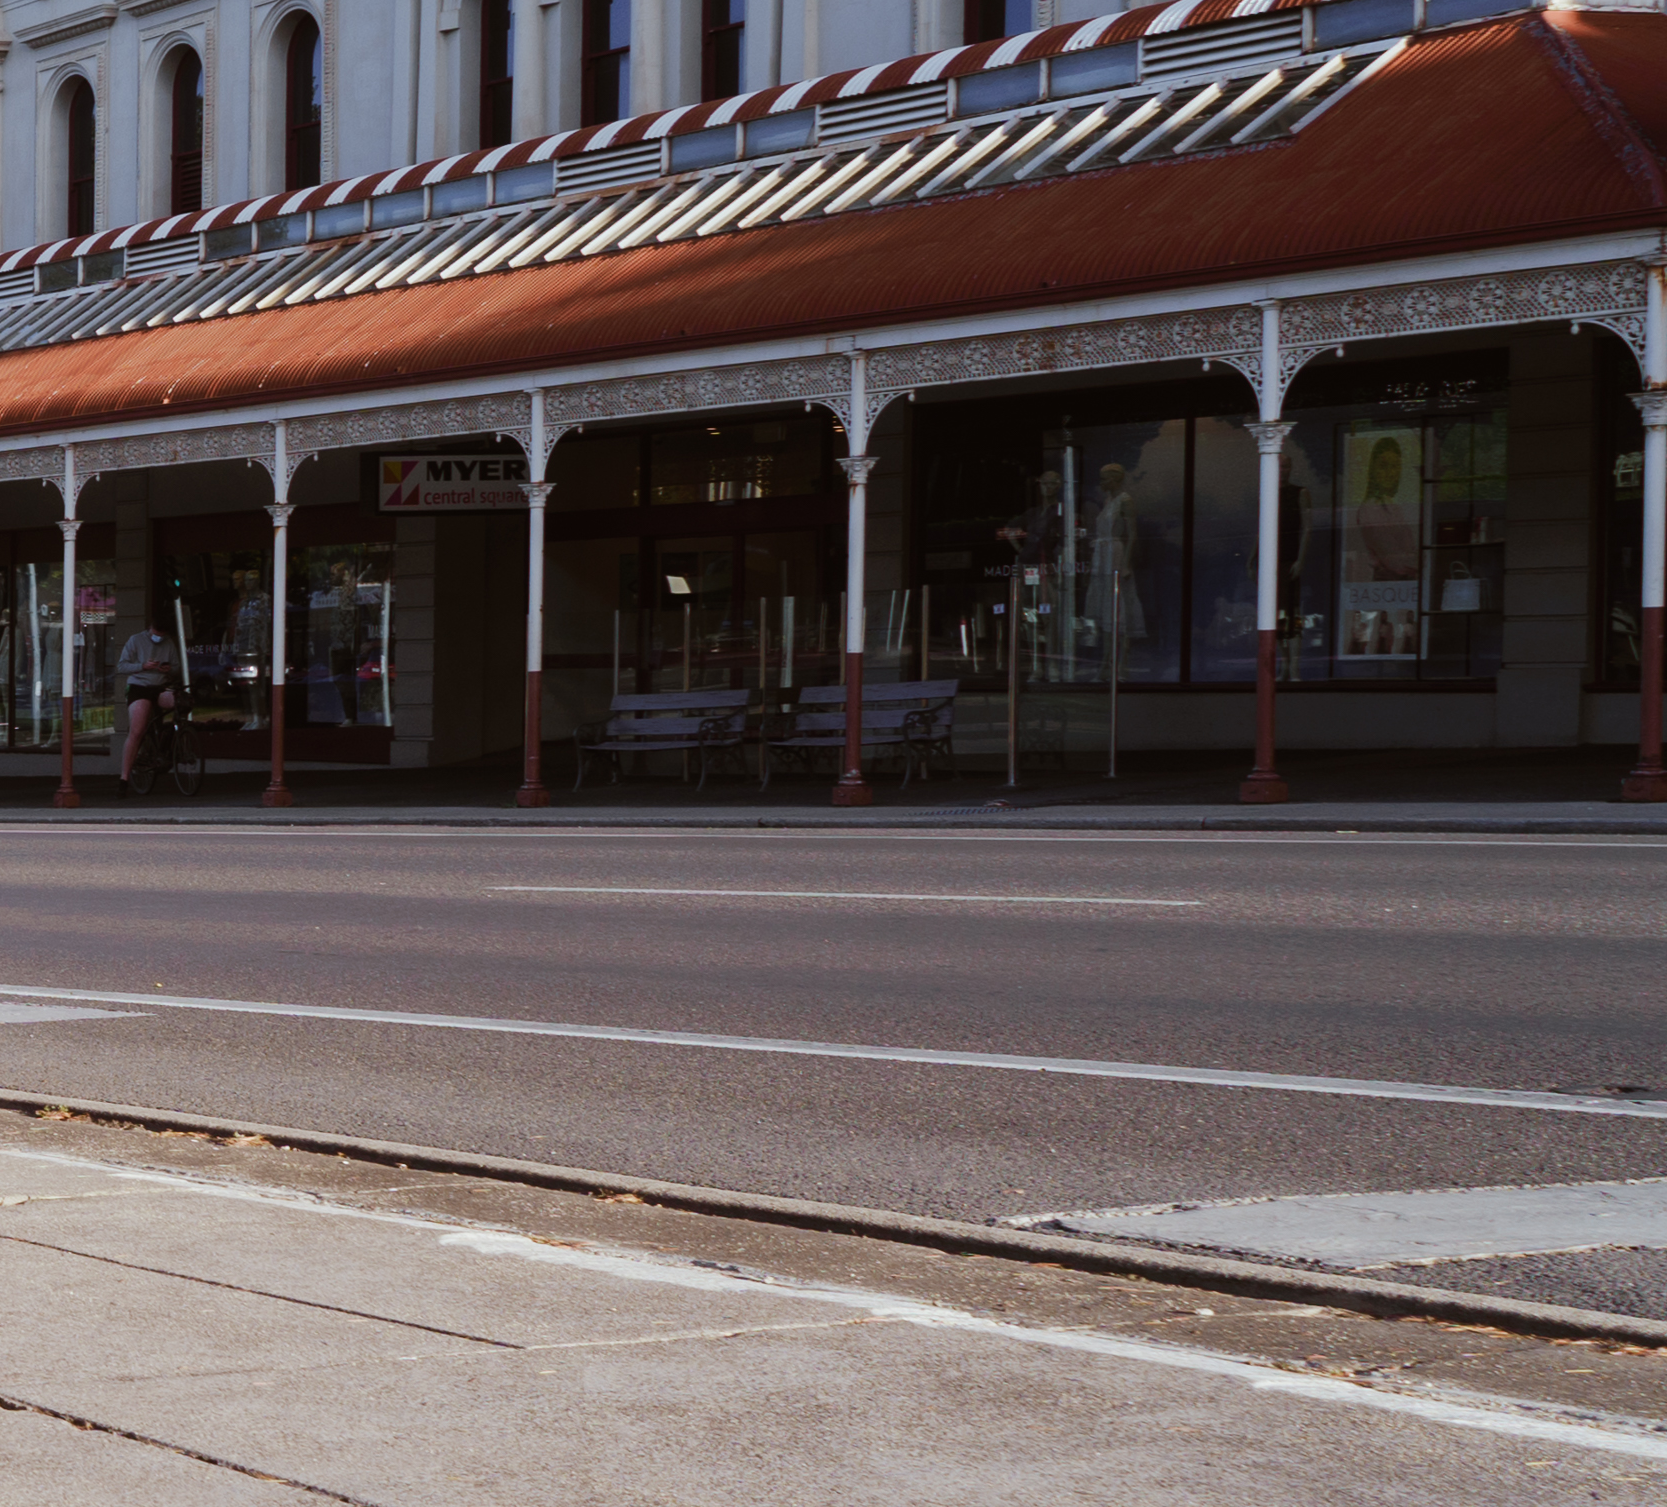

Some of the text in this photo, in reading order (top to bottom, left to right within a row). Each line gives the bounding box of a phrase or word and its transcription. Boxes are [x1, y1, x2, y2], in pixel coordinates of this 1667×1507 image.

[426, 460, 527, 482] MYER
[424, 487, 530, 507] central square
[984, 565, 1019, 577] MADE
[1349, 587, 1419, 604] BASQUE
